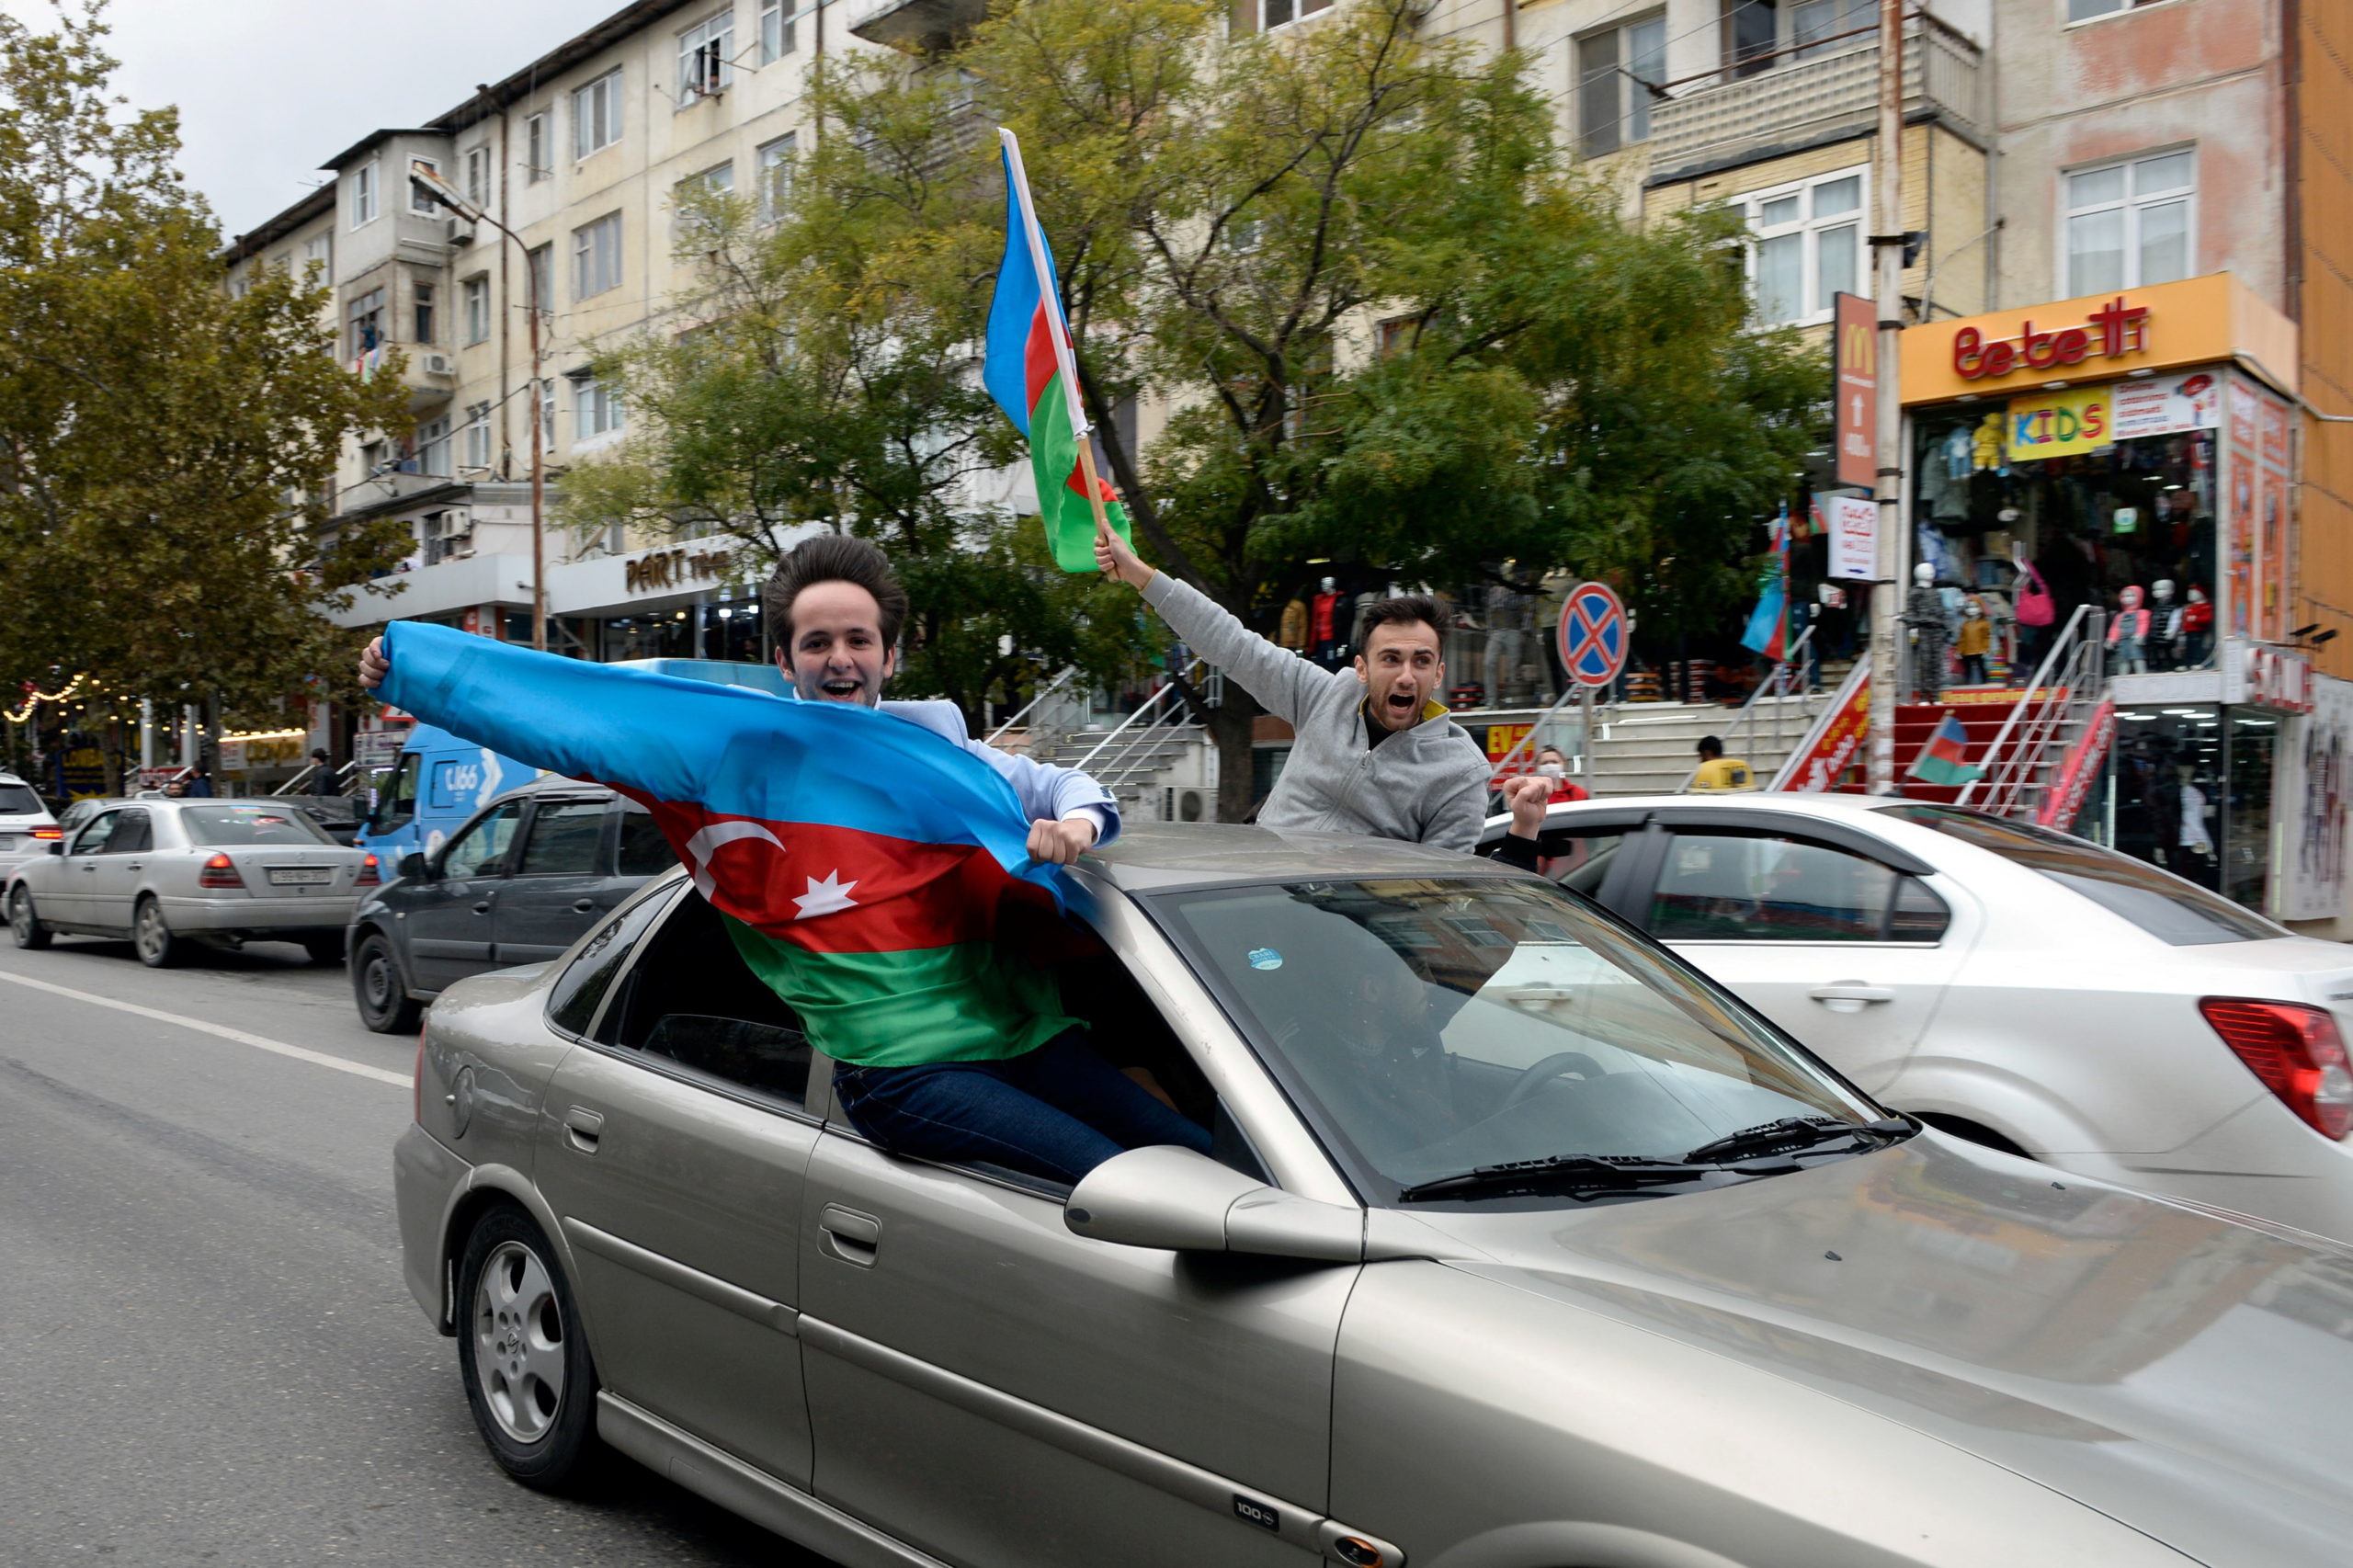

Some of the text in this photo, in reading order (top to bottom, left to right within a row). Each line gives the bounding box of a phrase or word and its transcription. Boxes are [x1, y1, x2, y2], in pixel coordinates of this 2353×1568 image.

[1954, 296, 2151, 379] Bebetti
[2015, 403, 2104, 448] KIDS
[626, 548, 687, 593] PART
[1237, 1502, 1261, 1520] 100
